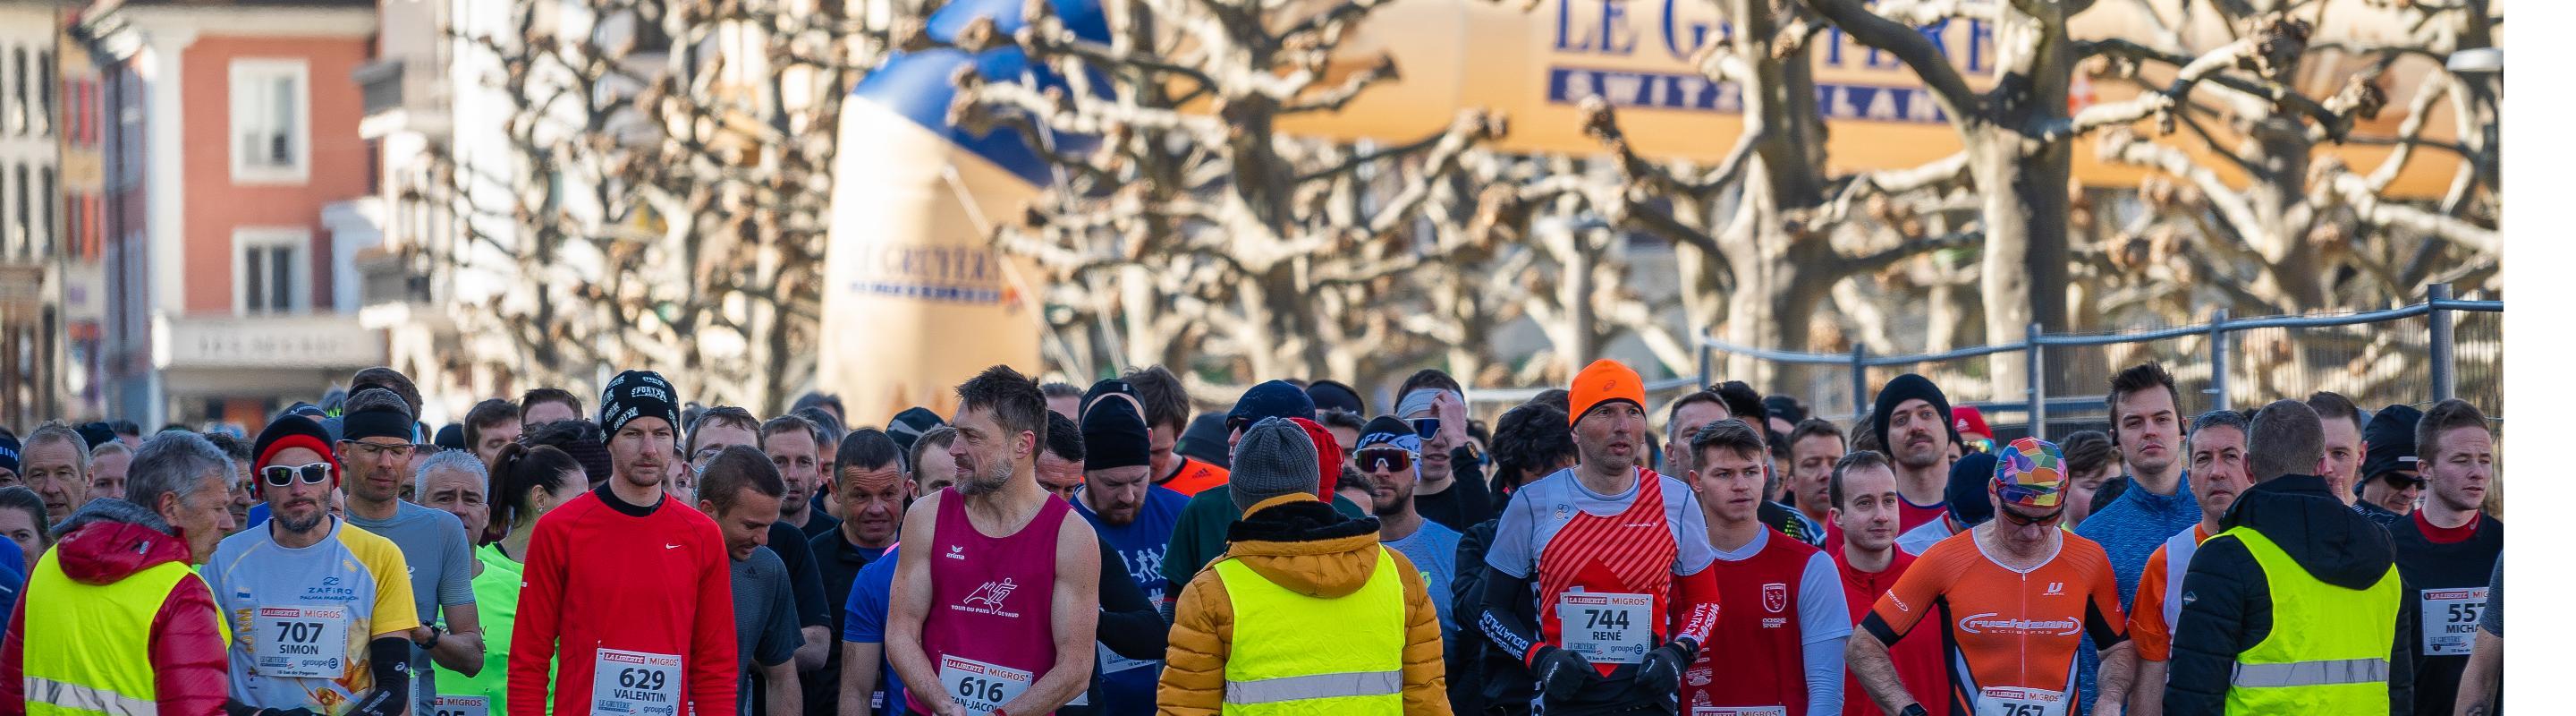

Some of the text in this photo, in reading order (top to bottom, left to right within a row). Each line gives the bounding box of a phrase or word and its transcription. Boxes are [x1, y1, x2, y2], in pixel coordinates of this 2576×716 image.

[1554, 0, 1636, 55] LE
[0, 447, 18, 462] IN
[945, 552, 965, 560] erima
[1611, 597, 1645, 606] MIGROS
[304, 609, 341, 618] MIGROS
[1584, 609, 1630, 630] 744
[276, 621, 324, 644] 707
[1592, 629, 1622, 641] RENÉ
[279, 644, 319, 655] SIMON
[1610, 644, 1634, 653] groupe
[301, 660, 328, 668] groupe
[648, 657, 678, 667] MIGROS
[619, 668, 665, 691] 629
[987, 668, 1026, 682] MIGROS
[959, 676, 1004, 703] 616
[614, 688, 667, 703] VALENTIN
[2029, 692, 2059, 702] MIGROS
[447, 698, 482, 707] MIGROS
[643, 705, 666, 715] groupe
[2003, 703, 2046, 716] 767
